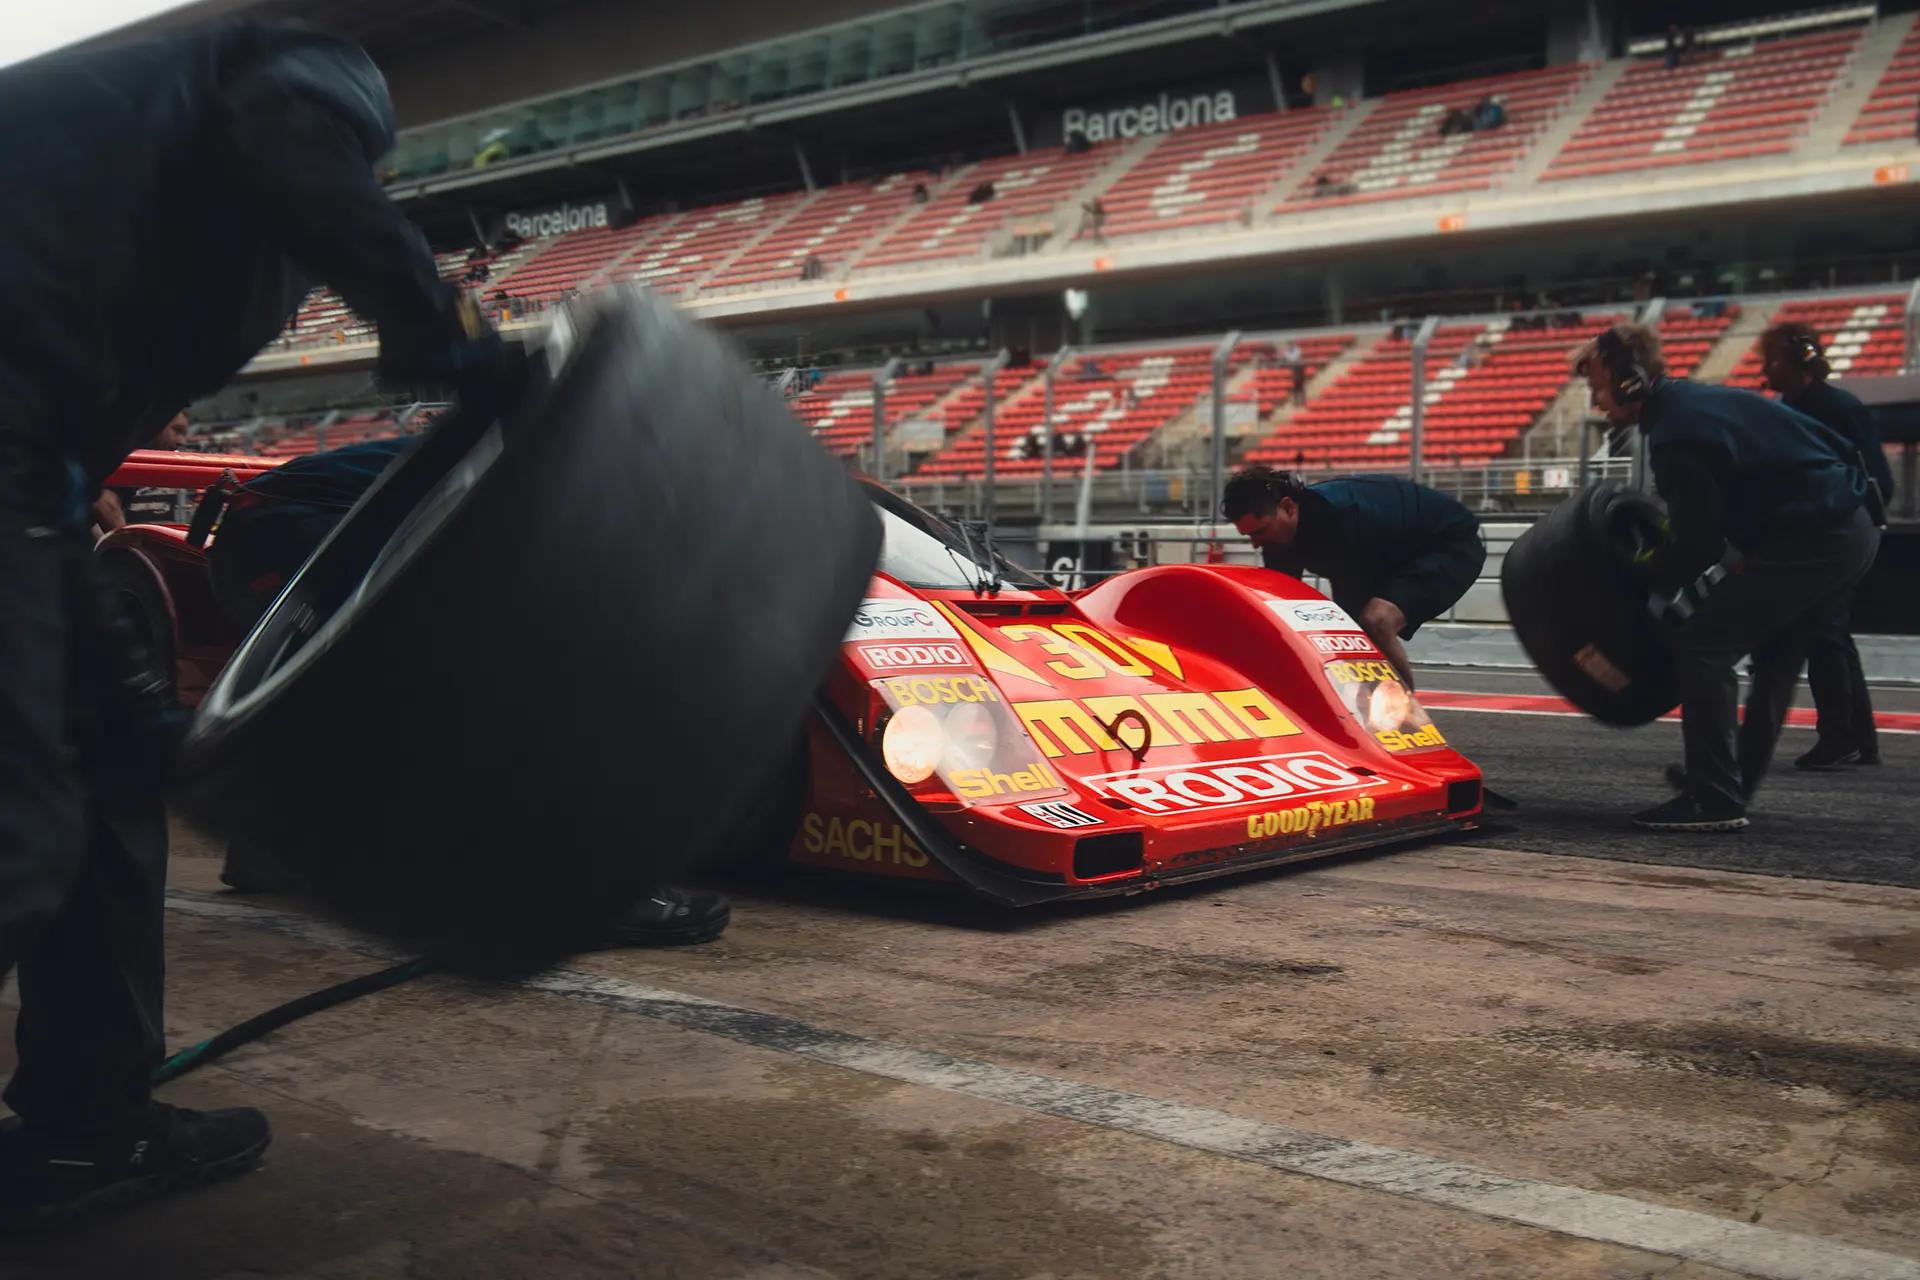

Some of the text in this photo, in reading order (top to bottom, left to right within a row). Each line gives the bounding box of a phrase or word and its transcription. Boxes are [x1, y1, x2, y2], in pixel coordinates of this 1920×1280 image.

[1063, 90, 1235, 143] Barcelona
[506, 203, 607, 237] Barcelona
[863, 645, 964, 666] RODIO
[999, 623, 1154, 680] 30
[1311, 636, 1372, 651] RODIO
[1329, 662, 1399, 684] BOSCH
[885, 677, 998, 705] BOSCH
[1011, 686, 1304, 758] momo
[1376, 723, 1447, 751] Shell
[948, 763, 1058, 797] Shell
[1104, 758, 1360, 811] RODIO
[1247, 796, 1376, 840] GOODYEAR
[803, 812, 930, 868] SACHS
